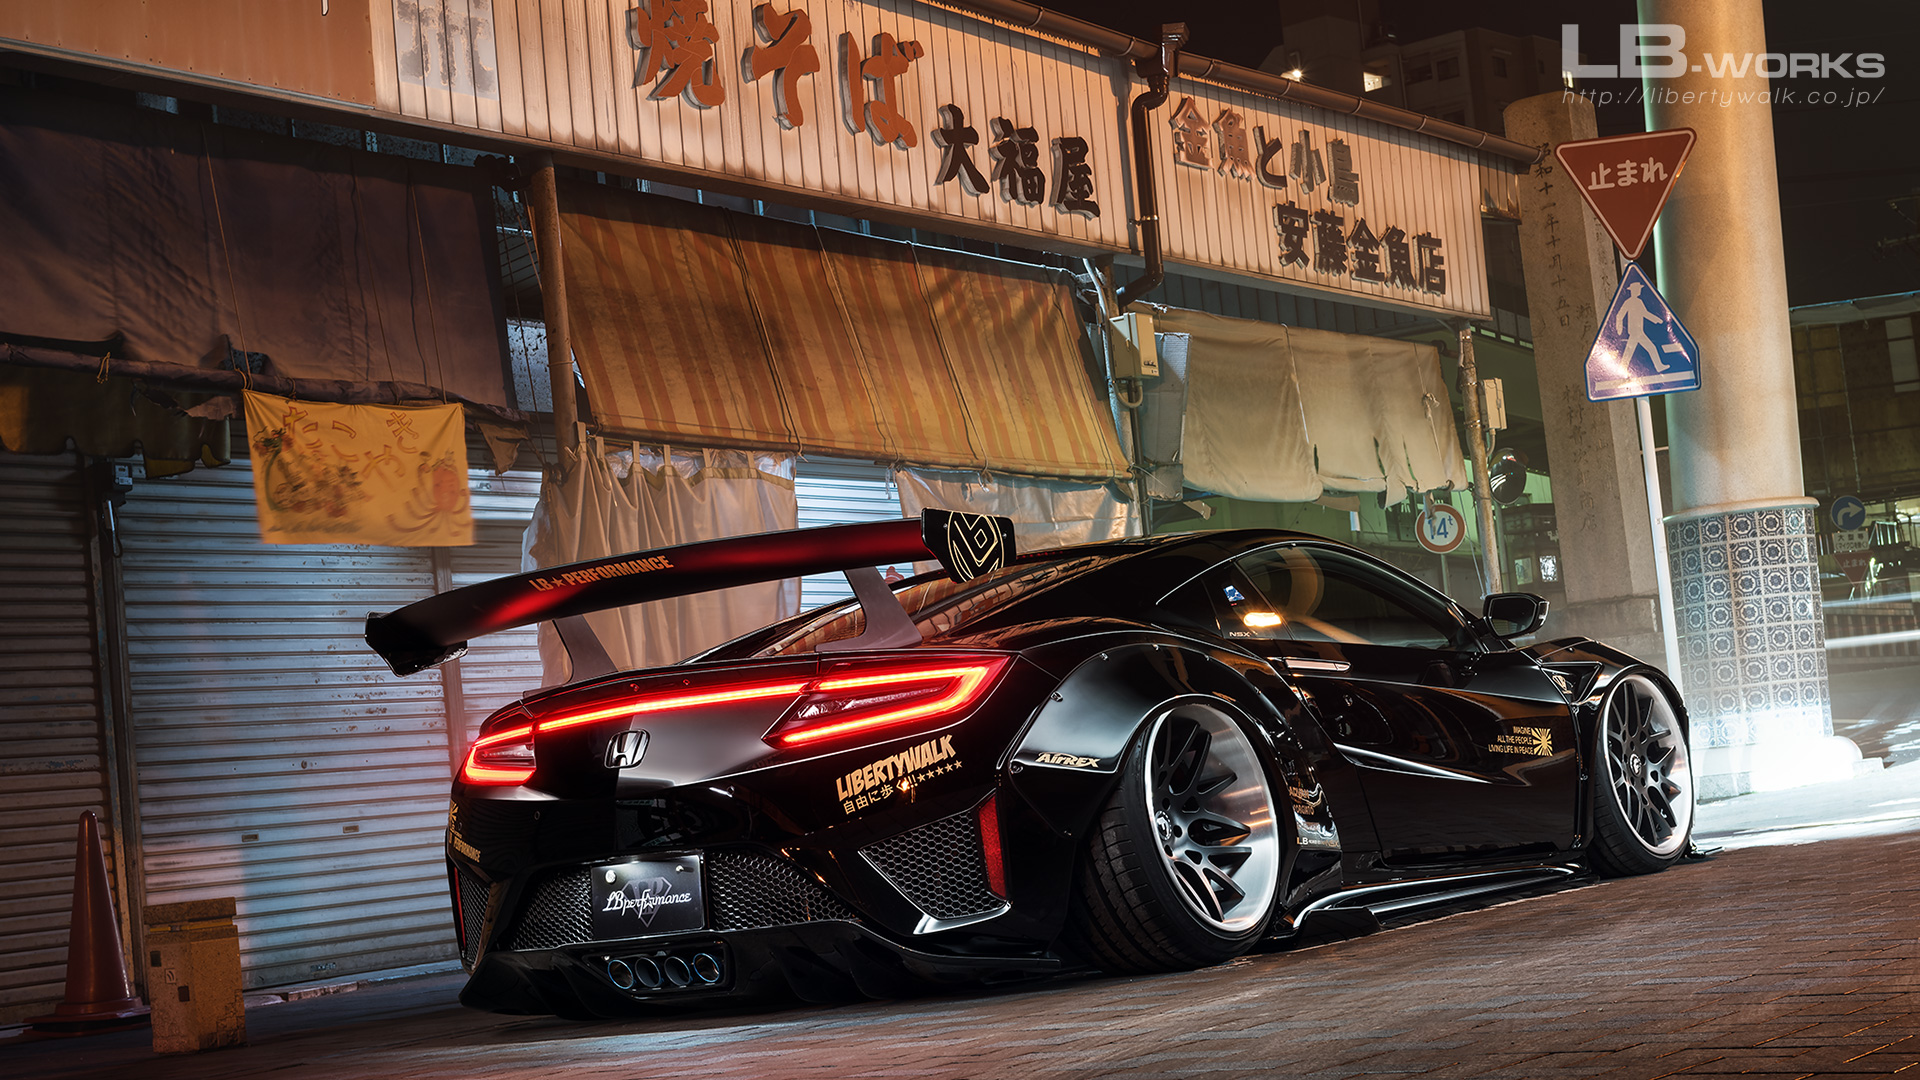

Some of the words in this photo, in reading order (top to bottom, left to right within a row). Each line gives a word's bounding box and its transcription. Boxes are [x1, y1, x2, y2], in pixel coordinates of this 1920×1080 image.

[627, 0, 924, 149] 焼そば
[932, 104, 1101, 220] 大福屋
[1169, 96, 1360, 207] 金魚と小鳥
[1587, 156, 1669, 191] 止まれ
[1272, 200, 1446, 297] 安藤金魚店
[561, 555, 674, 587] PERFORMANCE
[836, 734, 957, 801] LIBERTYWALK
